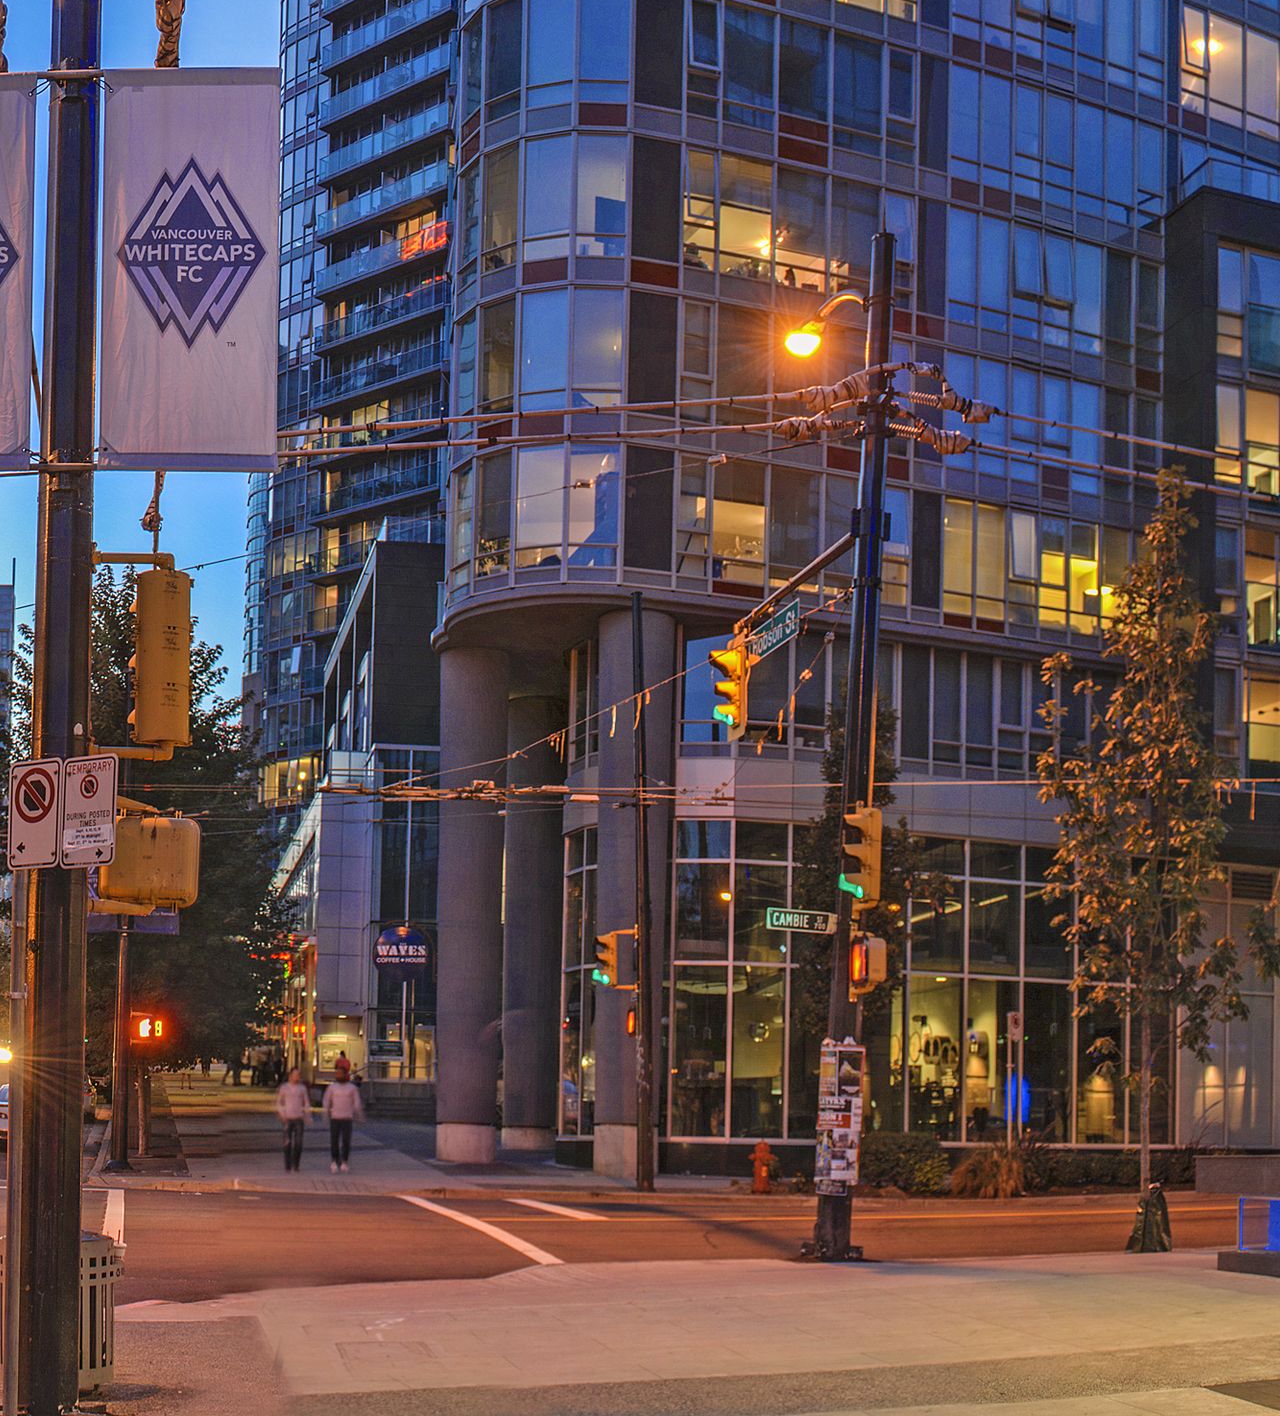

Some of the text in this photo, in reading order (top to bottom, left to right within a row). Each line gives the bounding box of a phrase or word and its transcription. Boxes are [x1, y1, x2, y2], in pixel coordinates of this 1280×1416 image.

[151, 229, 233, 240] VANCOUVER
[124, 244, 256, 262] WHITECAPS
[177, 265, 203, 282] FC
[786, 610, 796, 634] St
[68, 760, 113, 775] TEMPORARY
[66, 810, 111, 821] DURING POSTED
[80, 819, 96, 827] TIMES
[773, 912, 810, 928] CAMBIE
[376, 945, 427, 956] WAVES
